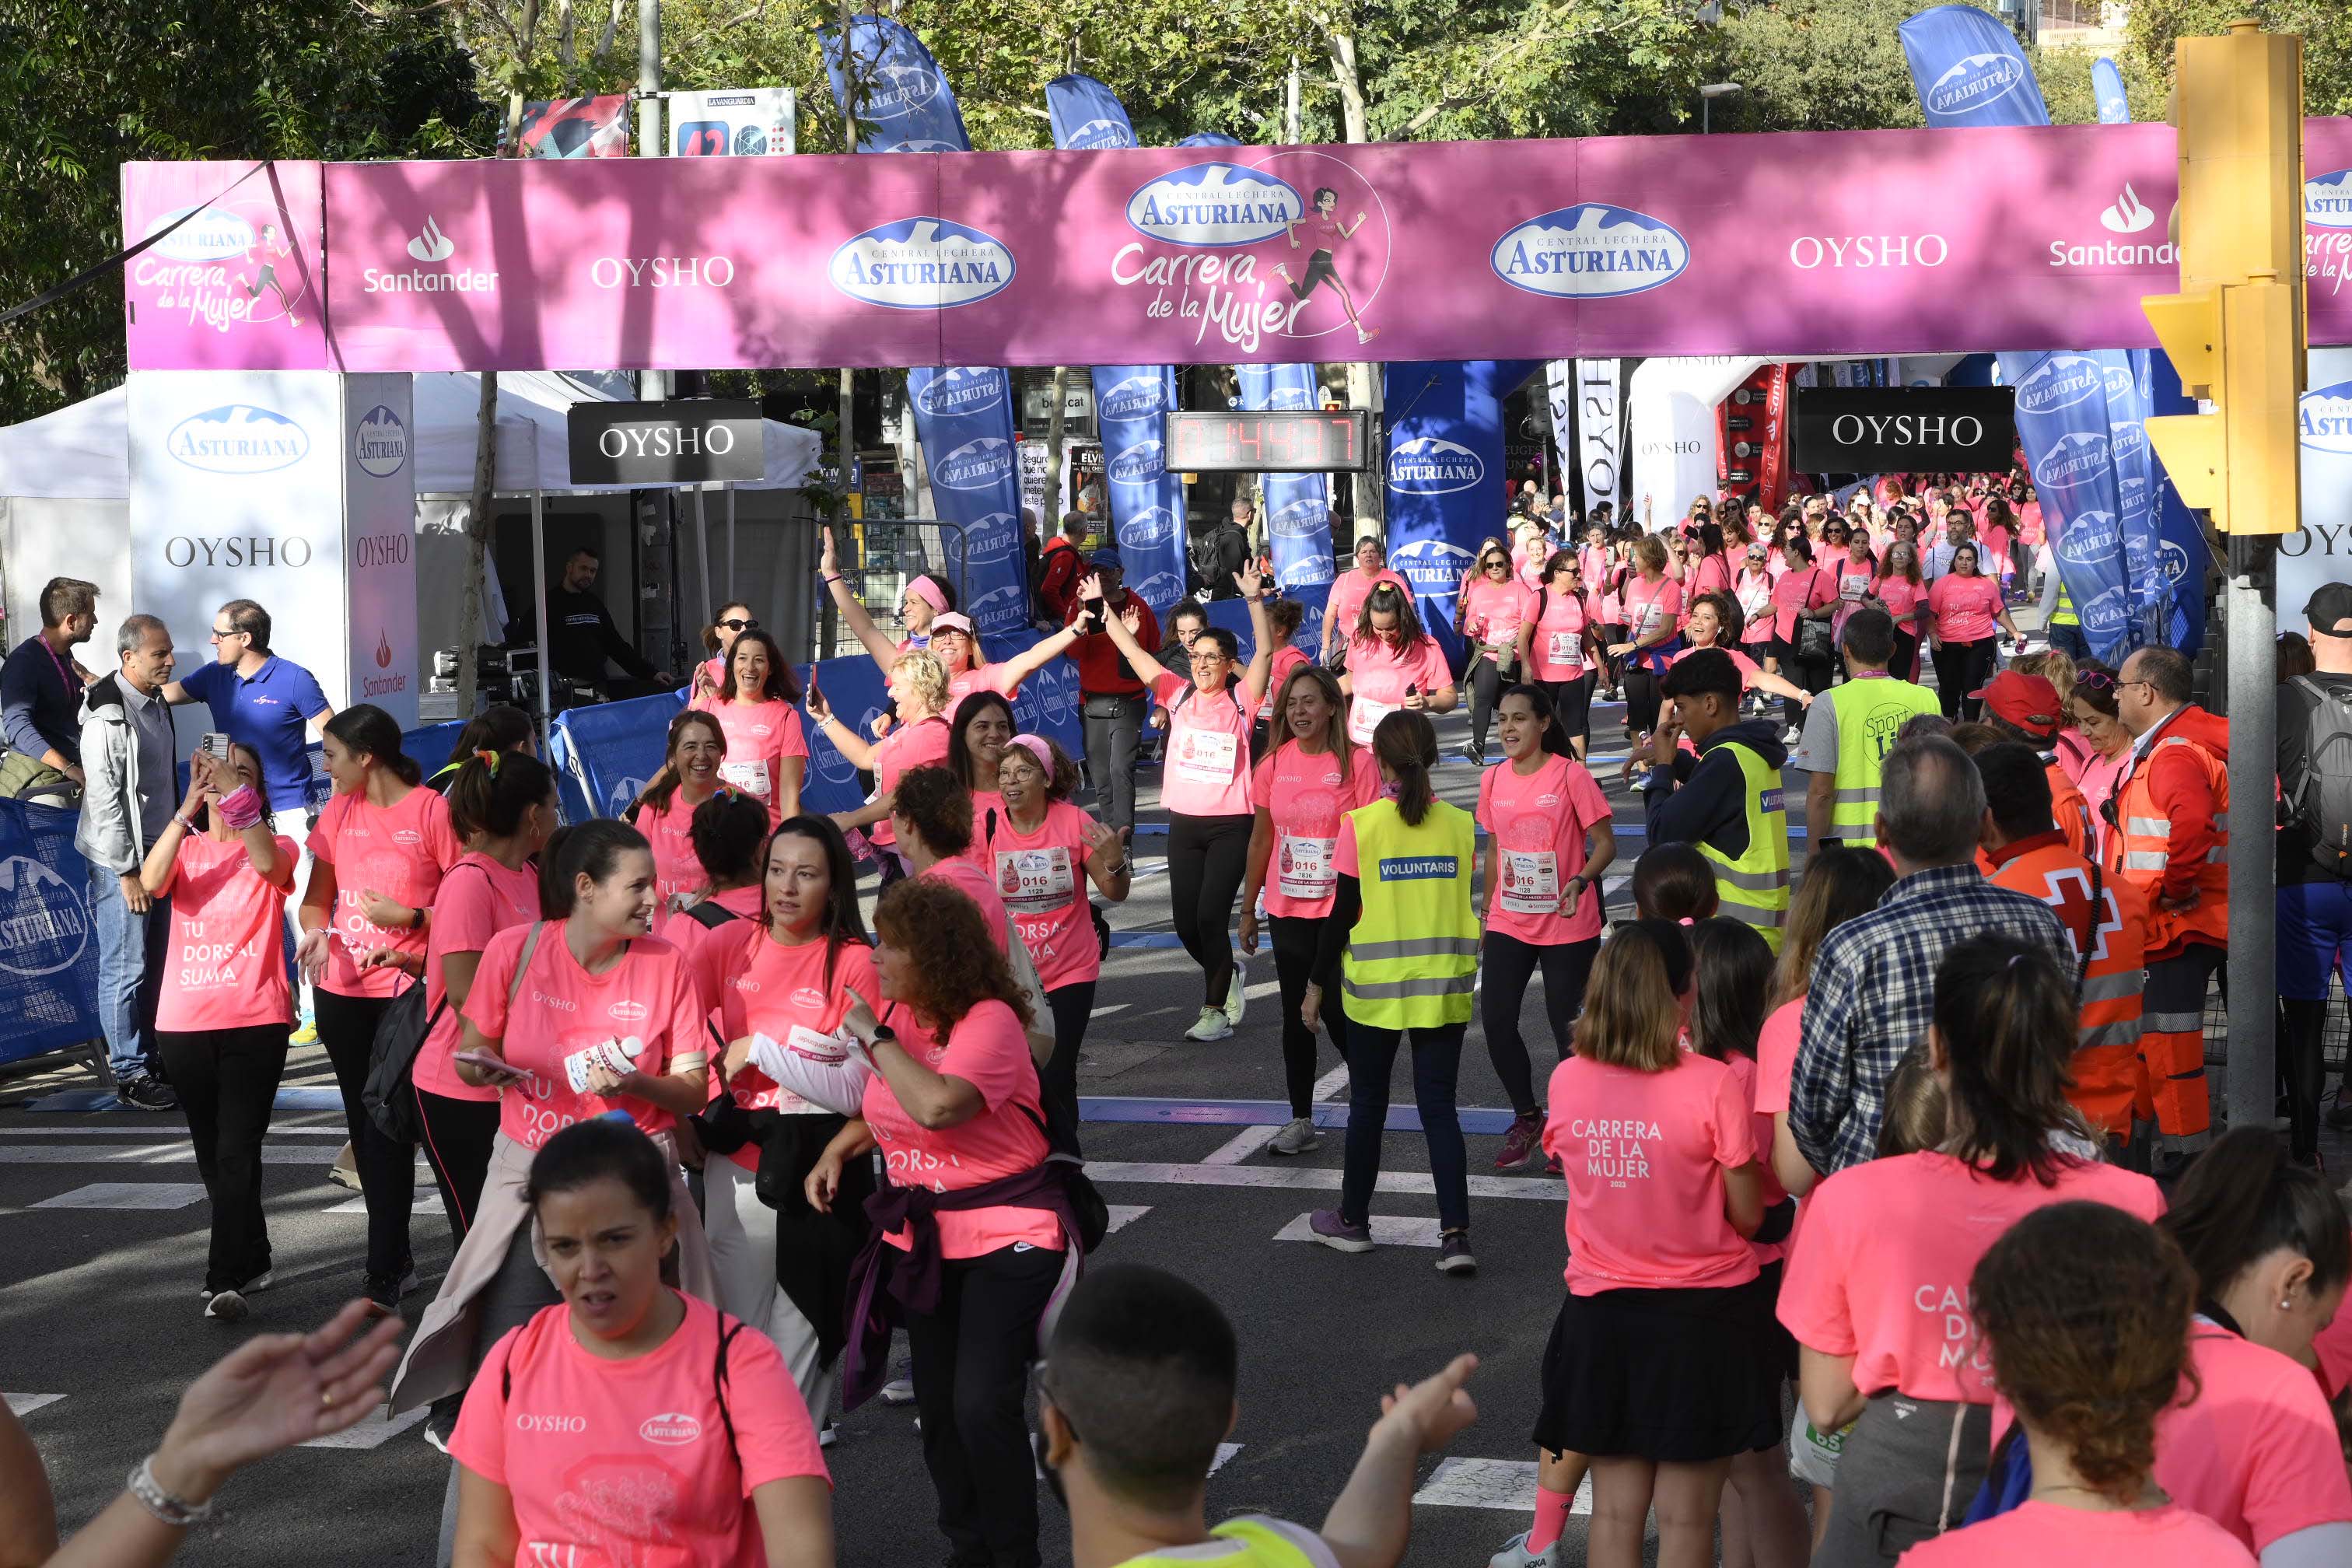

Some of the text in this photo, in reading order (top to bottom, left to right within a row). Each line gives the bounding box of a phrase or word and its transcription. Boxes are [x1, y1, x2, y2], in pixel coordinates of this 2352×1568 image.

[1139, 194, 1289, 226] ASTURIANA
[2305, 193, 2352, 214] STU
[1536, 235, 1668, 247] CENTRAL LECHERA
[1790, 234, 1948, 268] OYSHO
[845, 252, 1002, 285] ASTURIANA
[1111, 242, 1257, 286] Carrera
[1507, 240, 1674, 275] ASTURIANA
[135, 257, 228, 286] Carrera
[363, 268, 499, 292] Santander
[591, 256, 735, 289] OYSHO
[158, 285, 261, 333] de la Mujer
[1147, 282, 1312, 353] de la Mujer
[599, 425, 735, 459] OYSHO
[1832, 414, 1983, 446] OYSHO
[180, 432, 300, 457] ASTURIANA
[358, 432, 404, 460] ASTURIANA
[1389, 460, 1477, 482] ASTURIANA
[164, 536, 312, 568] OYSHO
[356, 533, 409, 569] OYSHO
[2277, 523, 2352, 557] OY
[363, 672, 406, 698] Santander
[1866, 709, 1909, 738] Sport
[1295, 861, 1317, 870] 016
[1381, 859, 1455, 876] VOLUNTARIS
[661, 880, 676, 895] TU
[1022, 876, 1048, 887] 016
[1516, 875, 1535, 885] 016
[341, 889, 358, 908] TU
[0, 907, 82, 950] STURIANA
[181, 920, 204, 939] TU
[183, 940, 257, 963] DORSAL
[180, 966, 236, 986] SUMA
[533, 991, 577, 1012] OYSHO
[1571, 1119, 1663, 1141] CARRERA
[1589, 1139, 1644, 1158] DE LA
[1587, 1160, 1650, 1178] MUJER
[1609, 1180, 1626, 1188] 2023
[516, 1412, 586, 1433] OYSHO
